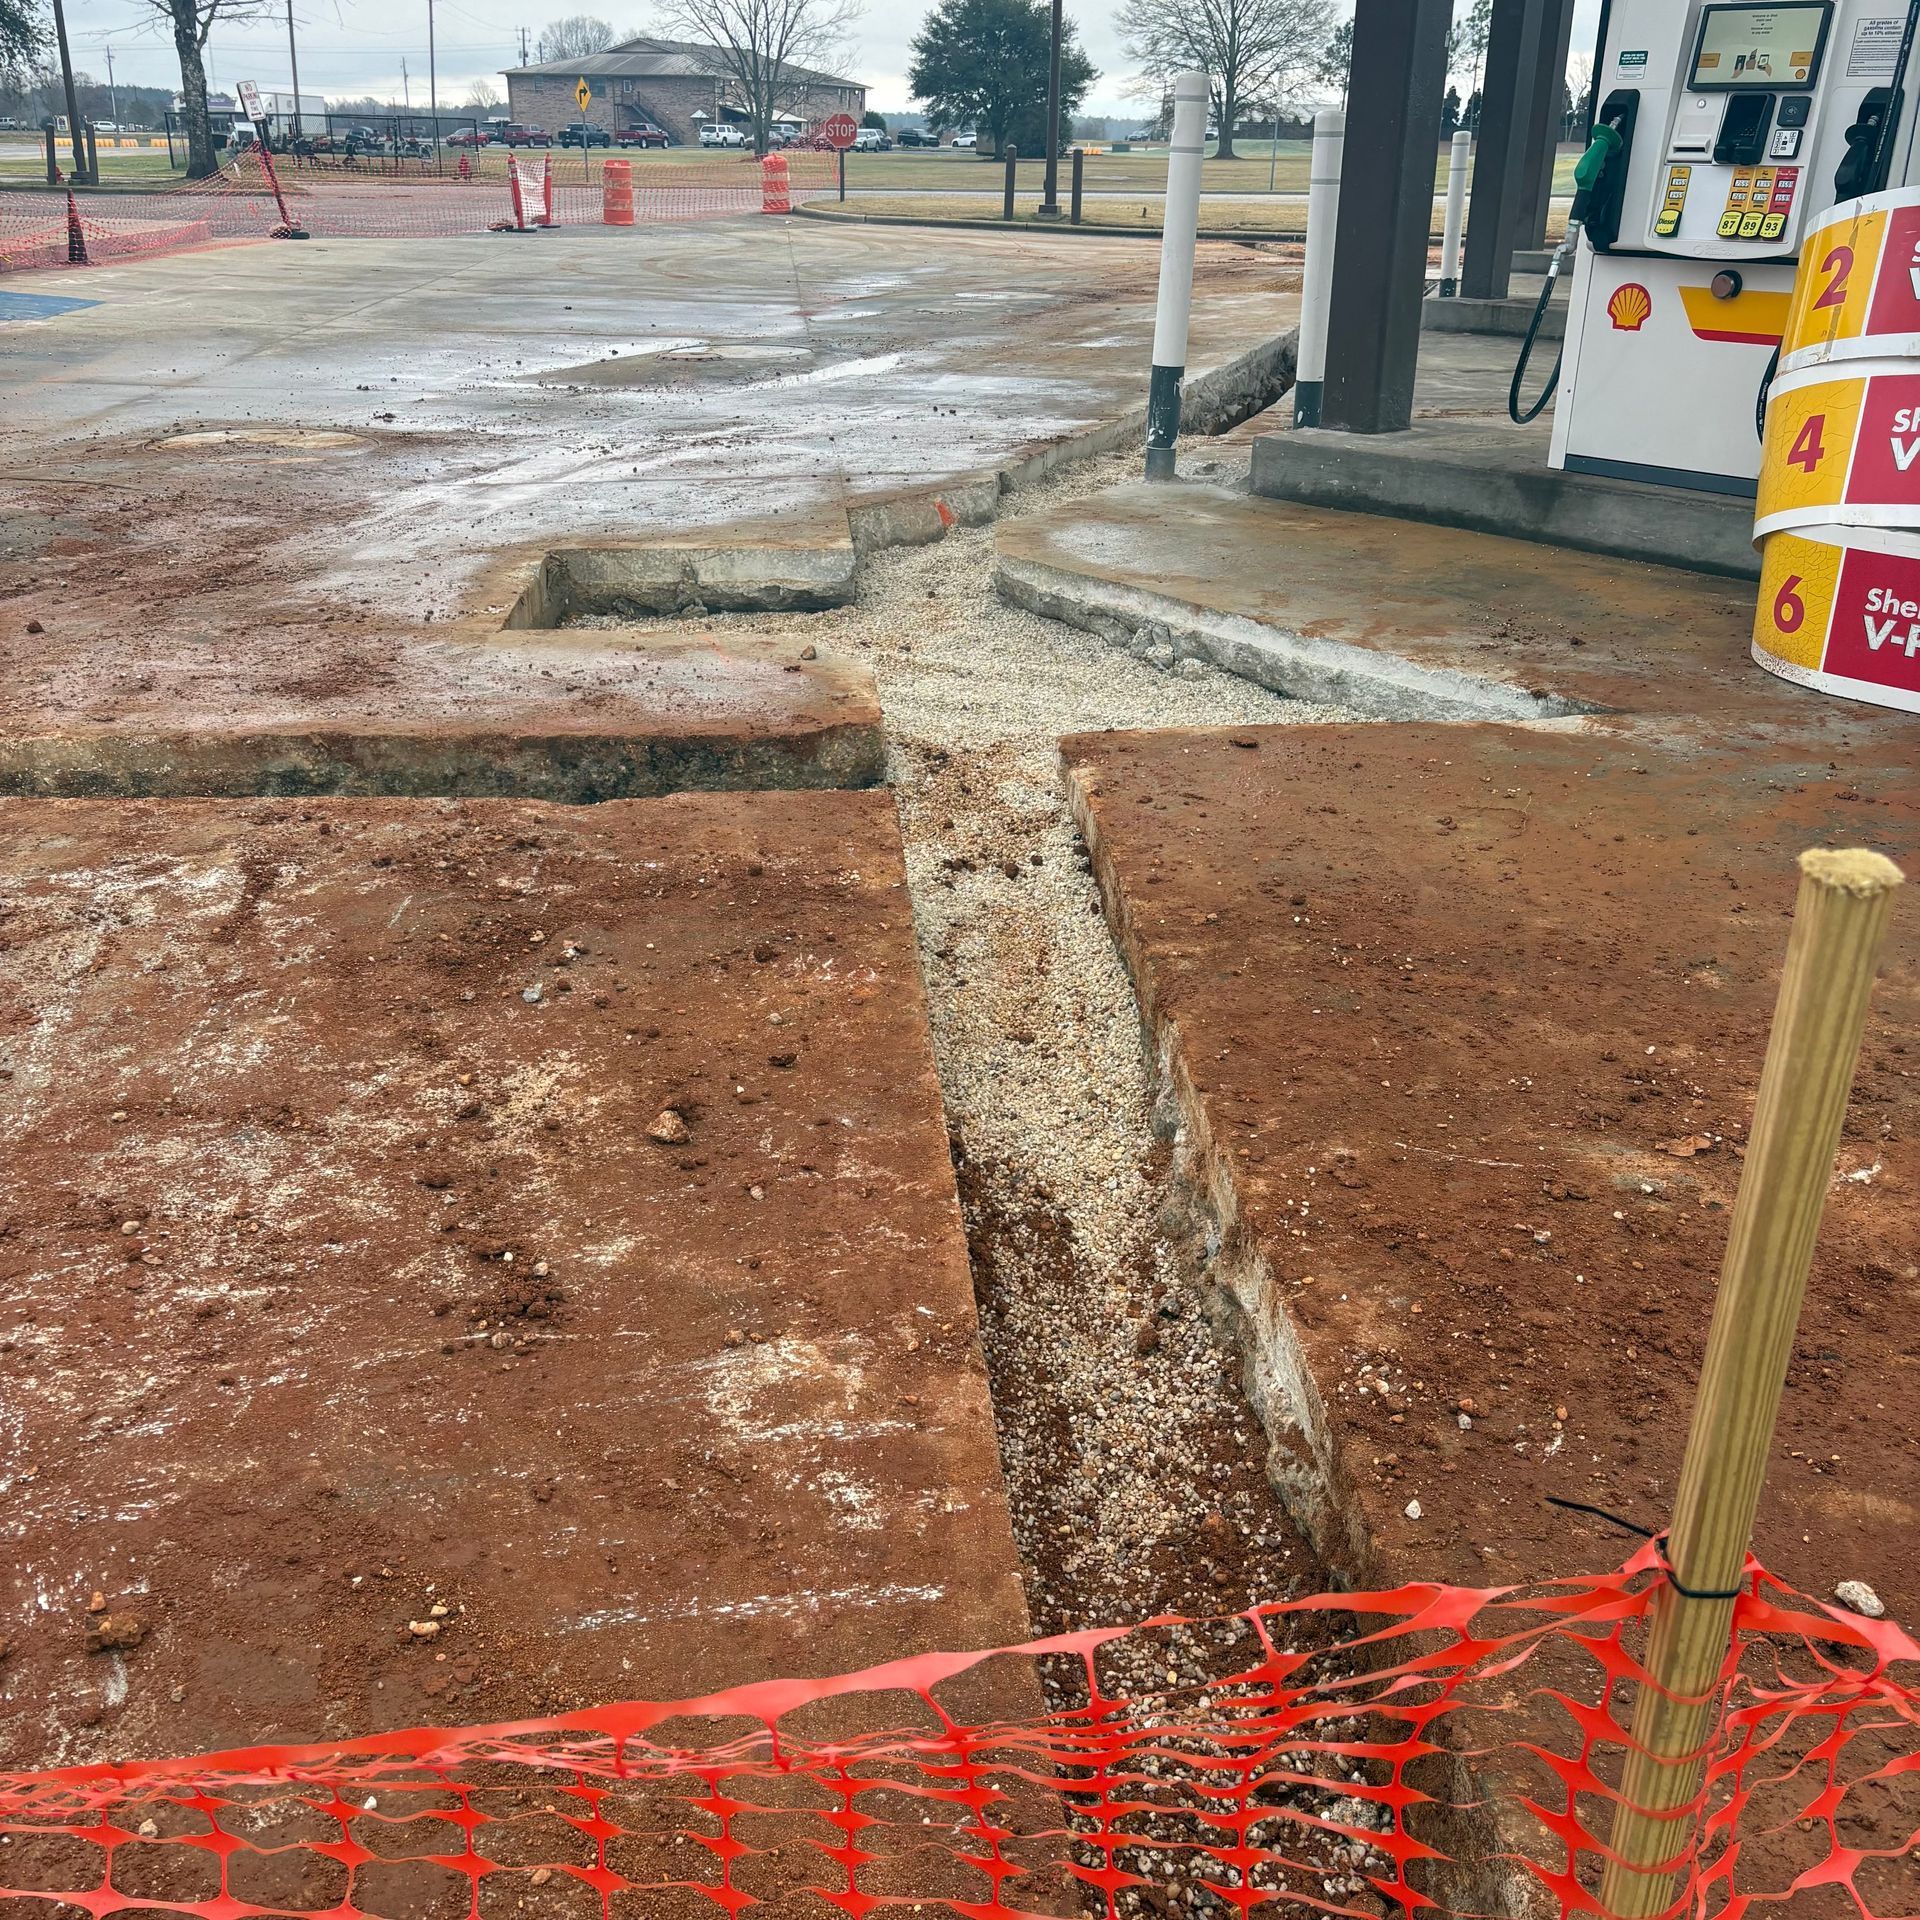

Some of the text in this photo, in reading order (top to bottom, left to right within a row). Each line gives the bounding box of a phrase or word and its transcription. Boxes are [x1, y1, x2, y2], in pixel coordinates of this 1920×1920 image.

[827, 124, 855, 137] STOP
[1722, 220, 1736, 230] 87
[1743, 221, 1757, 231] 89
[1764, 222, 1778, 231] 93
[1812, 246, 1854, 311] 2
[1787, 414, 1825, 473] 4
[1774, 574, 1804, 634] 6
[1864, 588, 1920, 620] She
